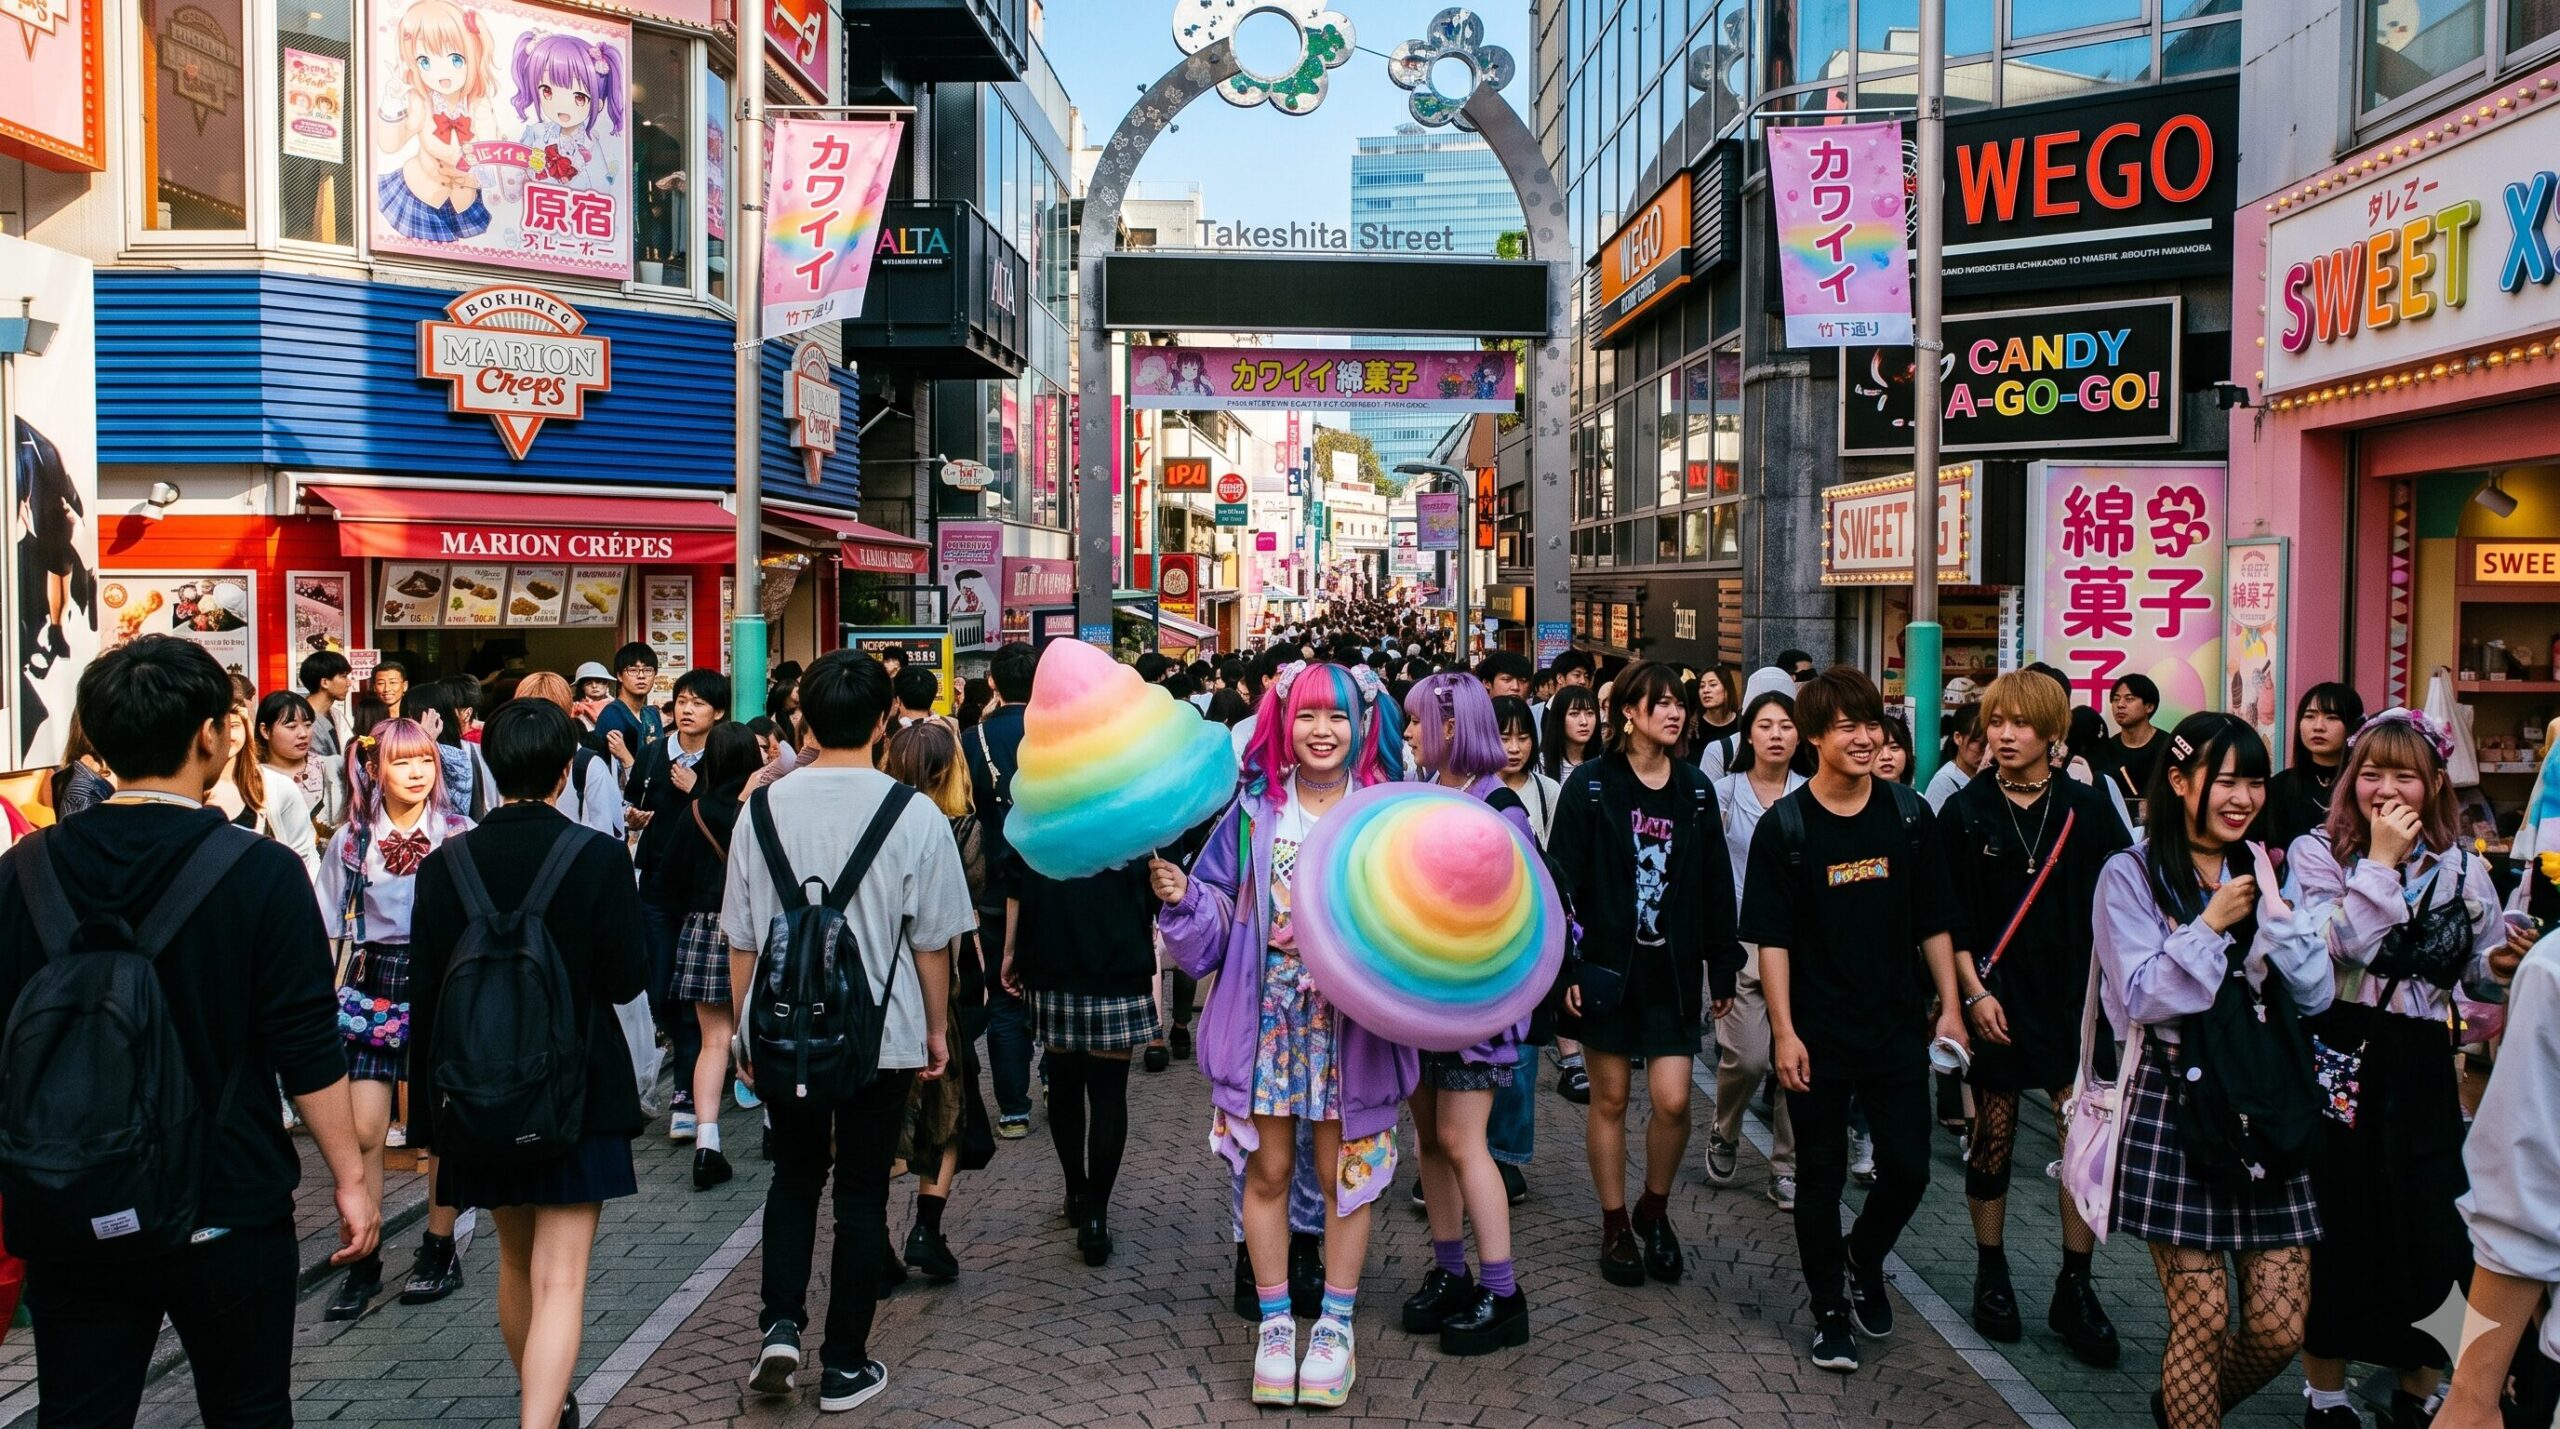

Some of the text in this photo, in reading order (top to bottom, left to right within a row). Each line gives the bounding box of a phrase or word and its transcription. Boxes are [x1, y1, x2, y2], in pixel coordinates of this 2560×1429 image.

[1956, 114, 2214, 225] WEGO
[524, 185, 612, 237] 原宿
[796, 135, 849, 290] カワイイ
[1196, 219, 1455, 251] Takeshita Street
[1810, 140, 1855, 303] カワイイ
[876, 228, 950, 254] ALTA
[1620, 205, 1662, 284] WEGO
[2281, 171, 2560, 354] SWEET X
[466, 293, 571, 325] BORHIREG
[1818, 321, 1879, 338] 竹下通り
[443, 335, 597, 376] MARION
[1968, 328, 2131, 375] CANDY
[476, 366, 566, 406] Creps
[1944, 371, 2160, 420] A-GO-GO!
[440, 531, 673, 559] MARION CRÉPES
[1839, 501, 1908, 561] SWEET
